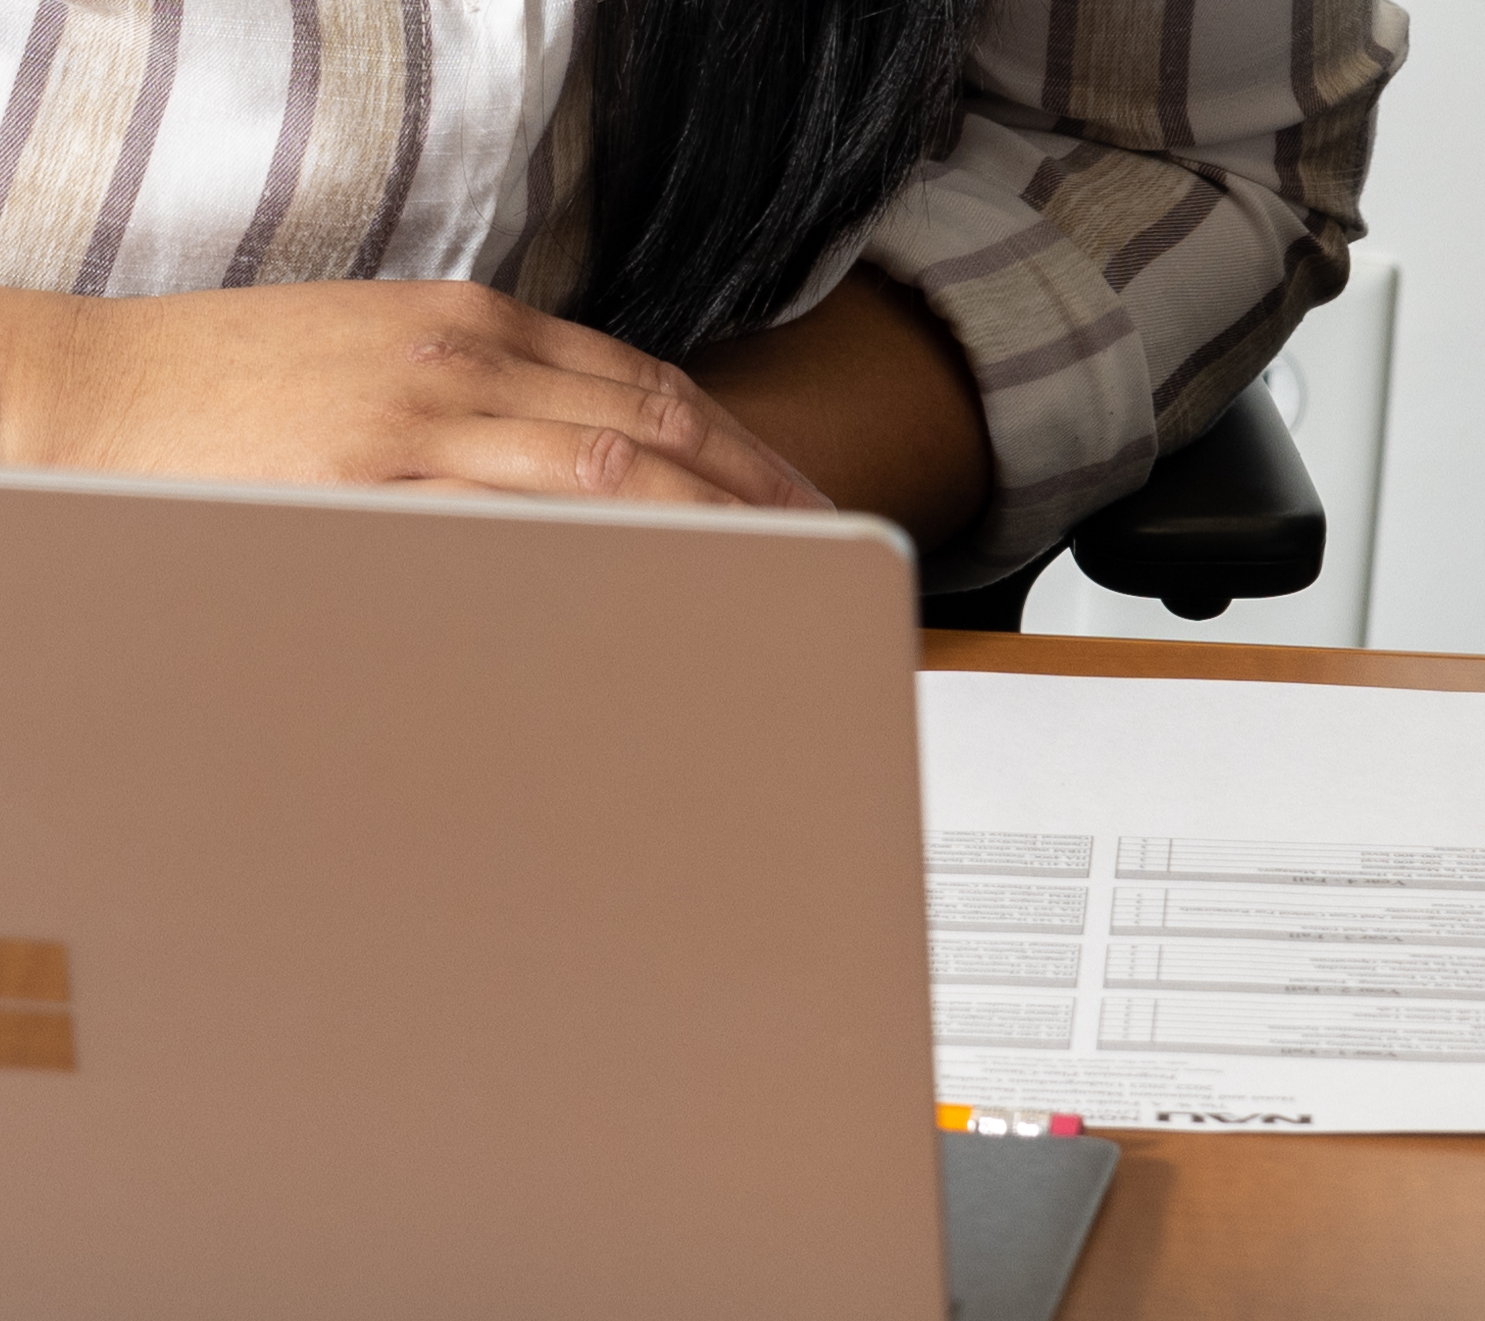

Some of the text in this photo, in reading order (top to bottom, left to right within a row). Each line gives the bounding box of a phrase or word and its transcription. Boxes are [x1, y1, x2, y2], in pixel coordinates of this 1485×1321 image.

[1364, 879, 1406, 887] Year
[1360, 935, 1403, 943] Year
[1157, 1112, 1312, 1124] NAU
